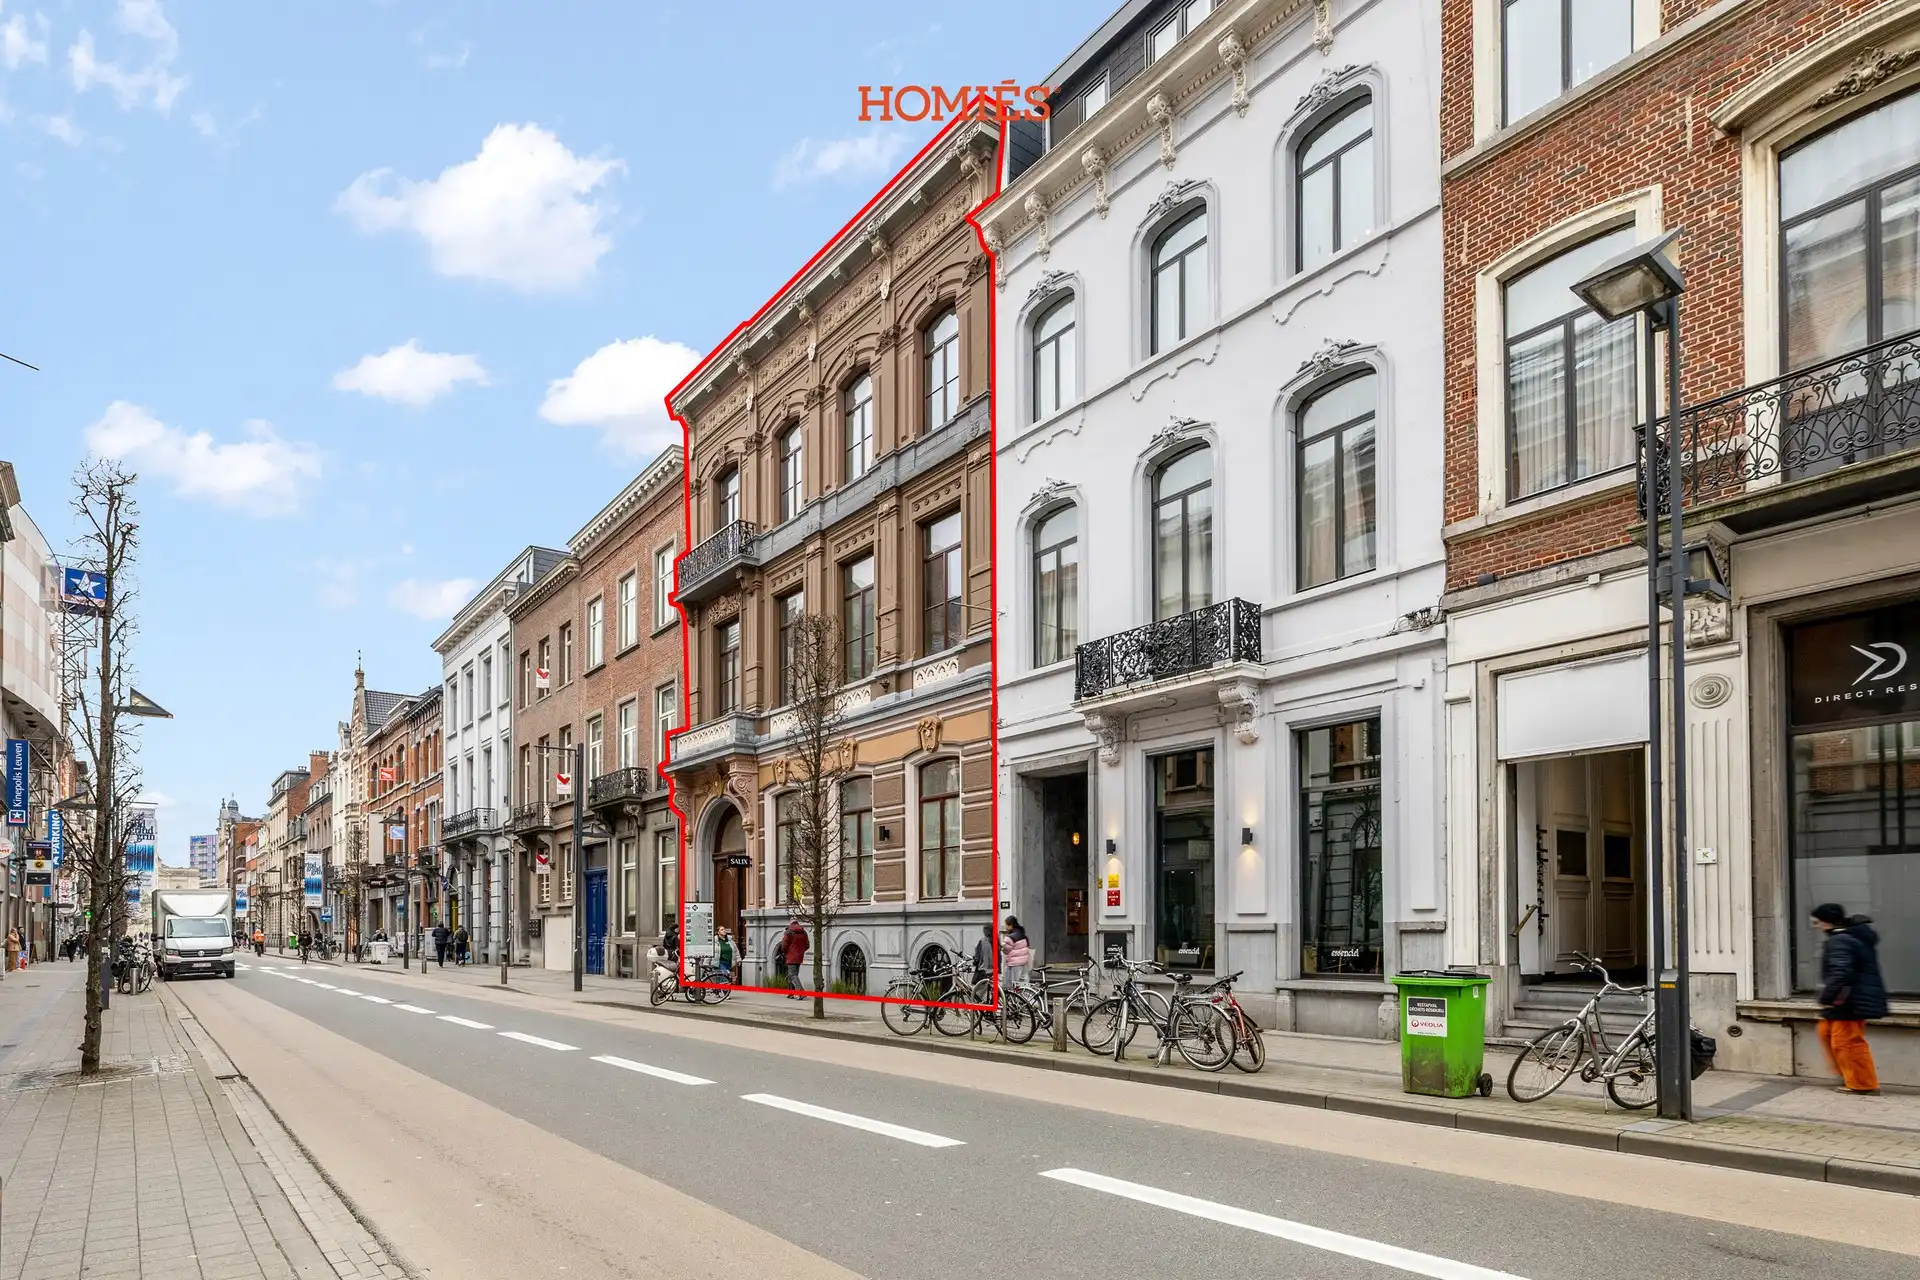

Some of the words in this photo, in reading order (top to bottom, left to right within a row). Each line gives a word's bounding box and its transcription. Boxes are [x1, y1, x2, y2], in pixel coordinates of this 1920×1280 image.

[1814, 689, 1875, 704] DIRECT
[1885, 683, 1918, 694] RES
[13, 742, 23, 771] Leuven
[12, 772, 25, 807] Kinepolis
[51, 813, 60, 854] PARKING
[730, 857, 748, 865] SALIX
[1420, 1021, 1444, 1029] VEOLIA
